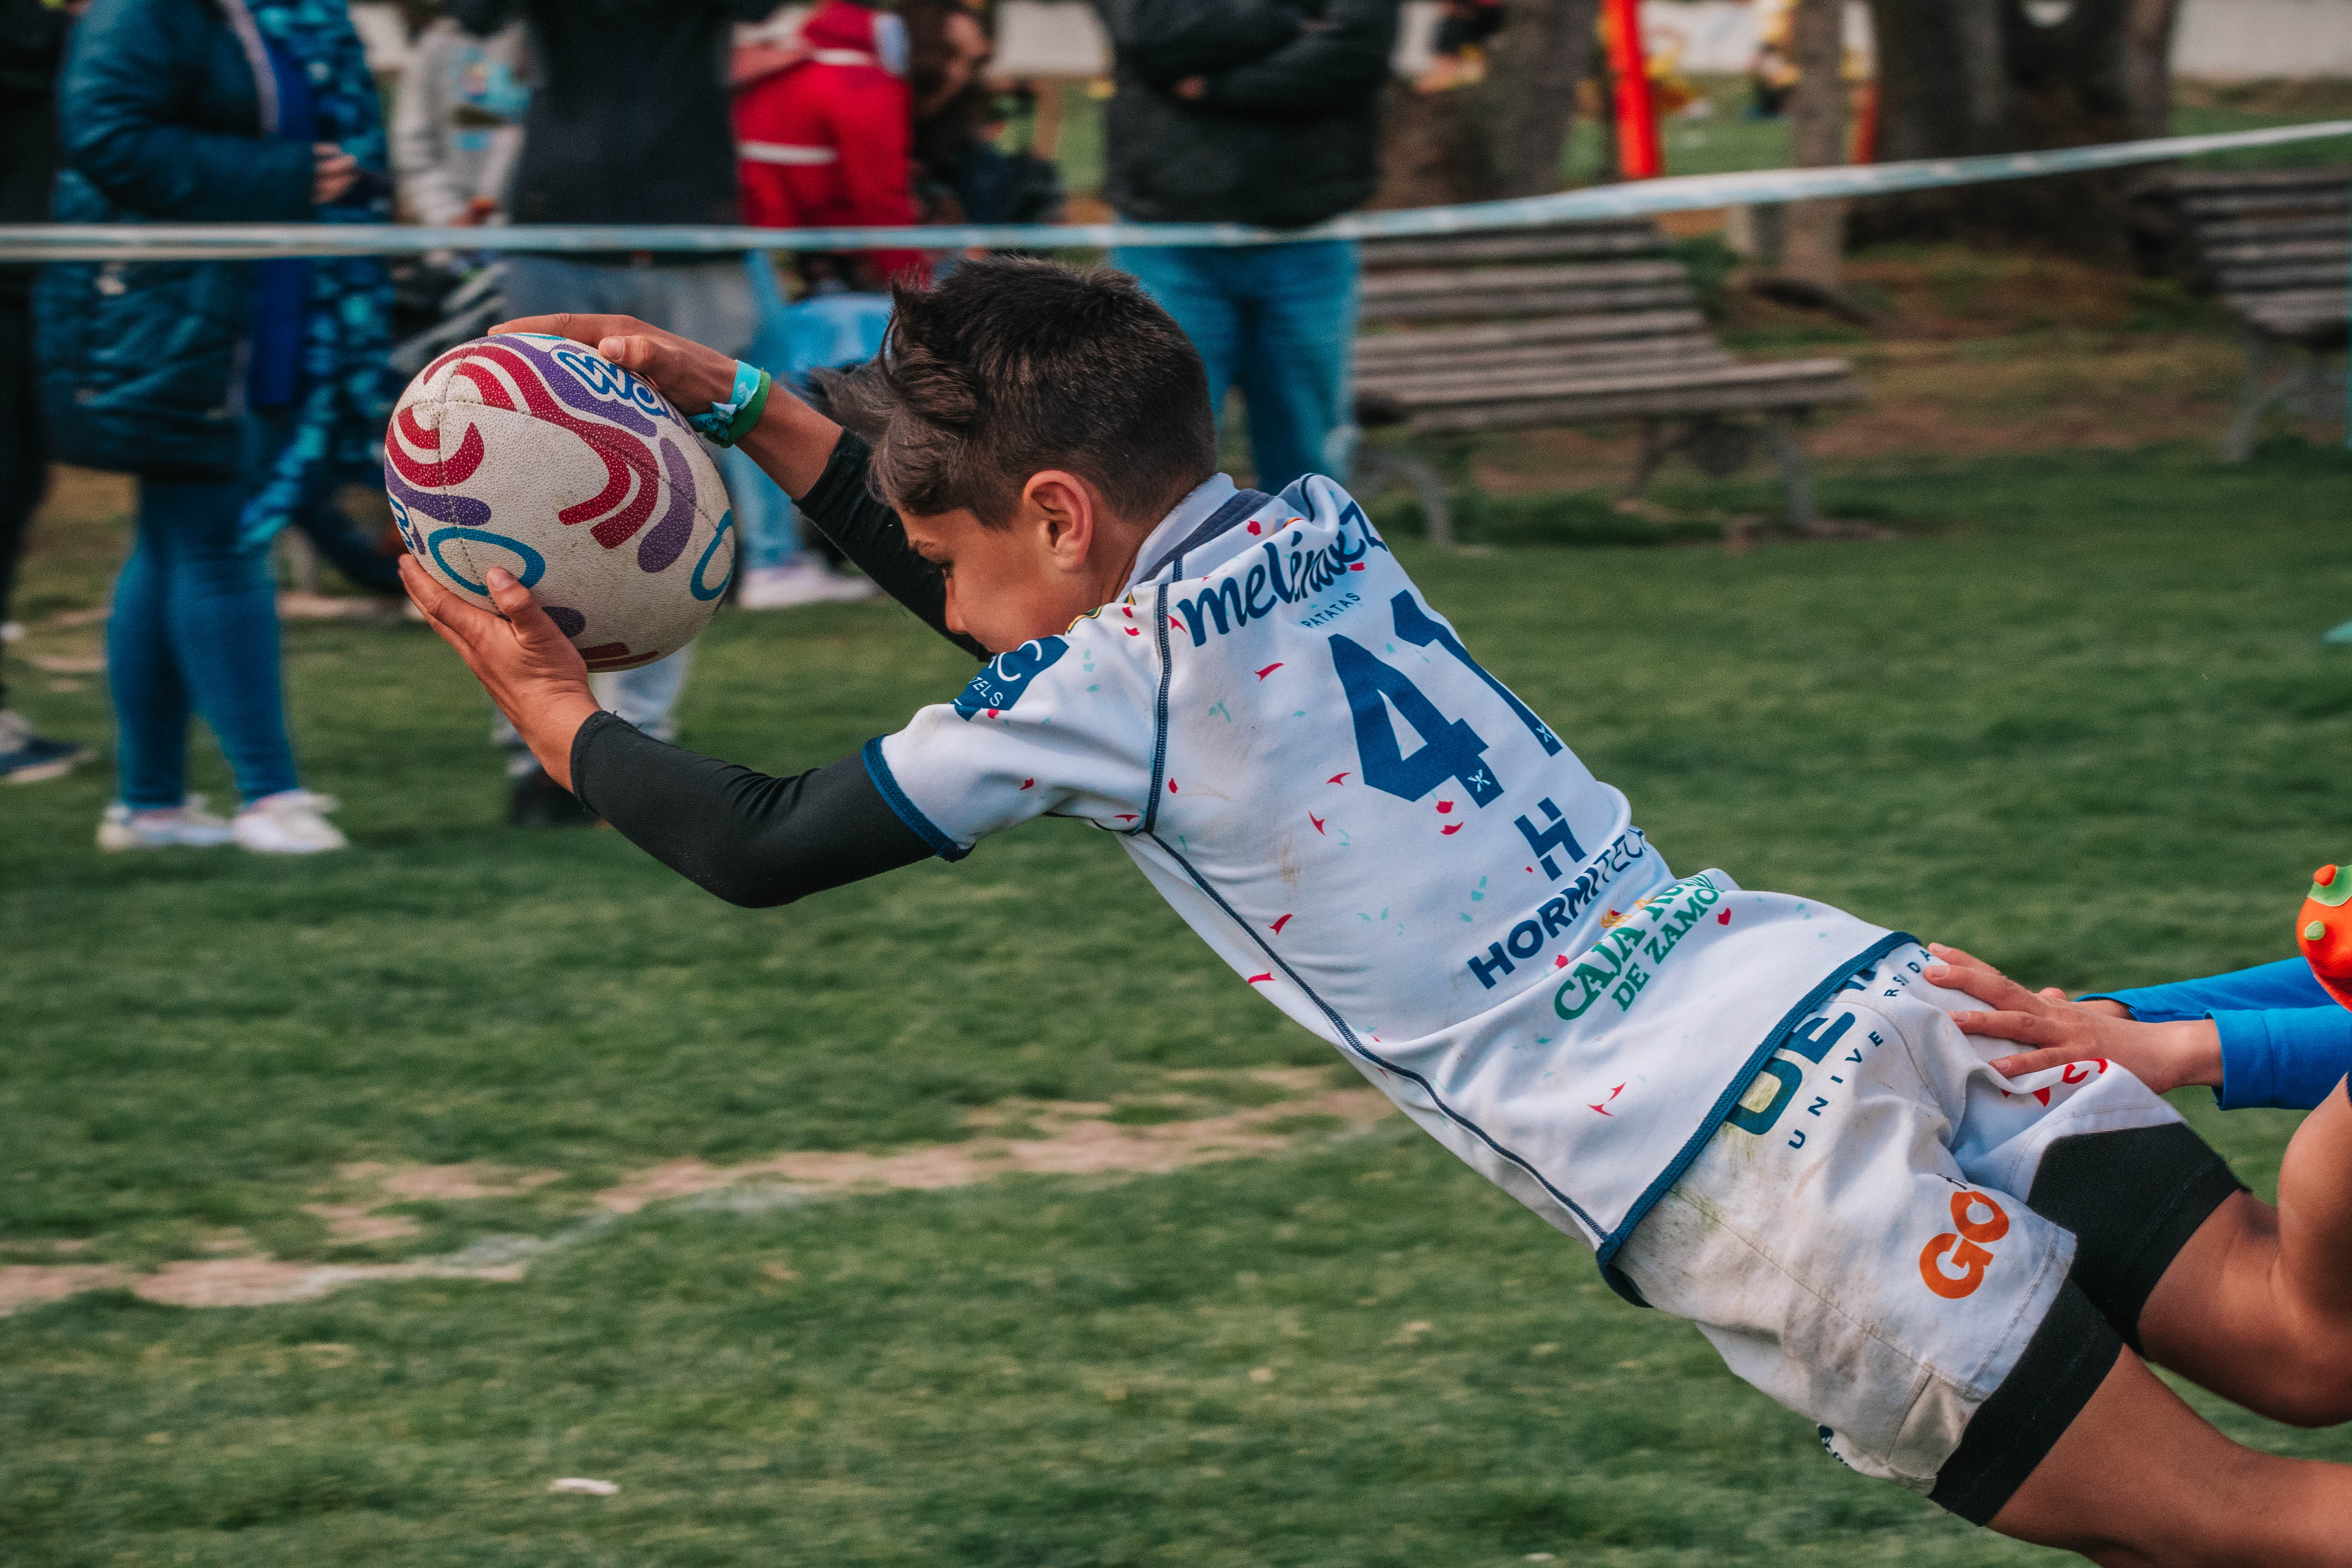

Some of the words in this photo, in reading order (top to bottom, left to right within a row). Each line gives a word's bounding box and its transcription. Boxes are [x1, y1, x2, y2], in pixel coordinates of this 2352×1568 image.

[1300, 593, 1361, 628] PATATAS
[1328, 589, 1563, 808] 41
[1554, 926, 1647, 1021] CAJA
[1612, 962, 1650, 1012] DE
[1644, 888, 1726, 965] ZAMO
[1919, 1190, 2010, 1299] GO
